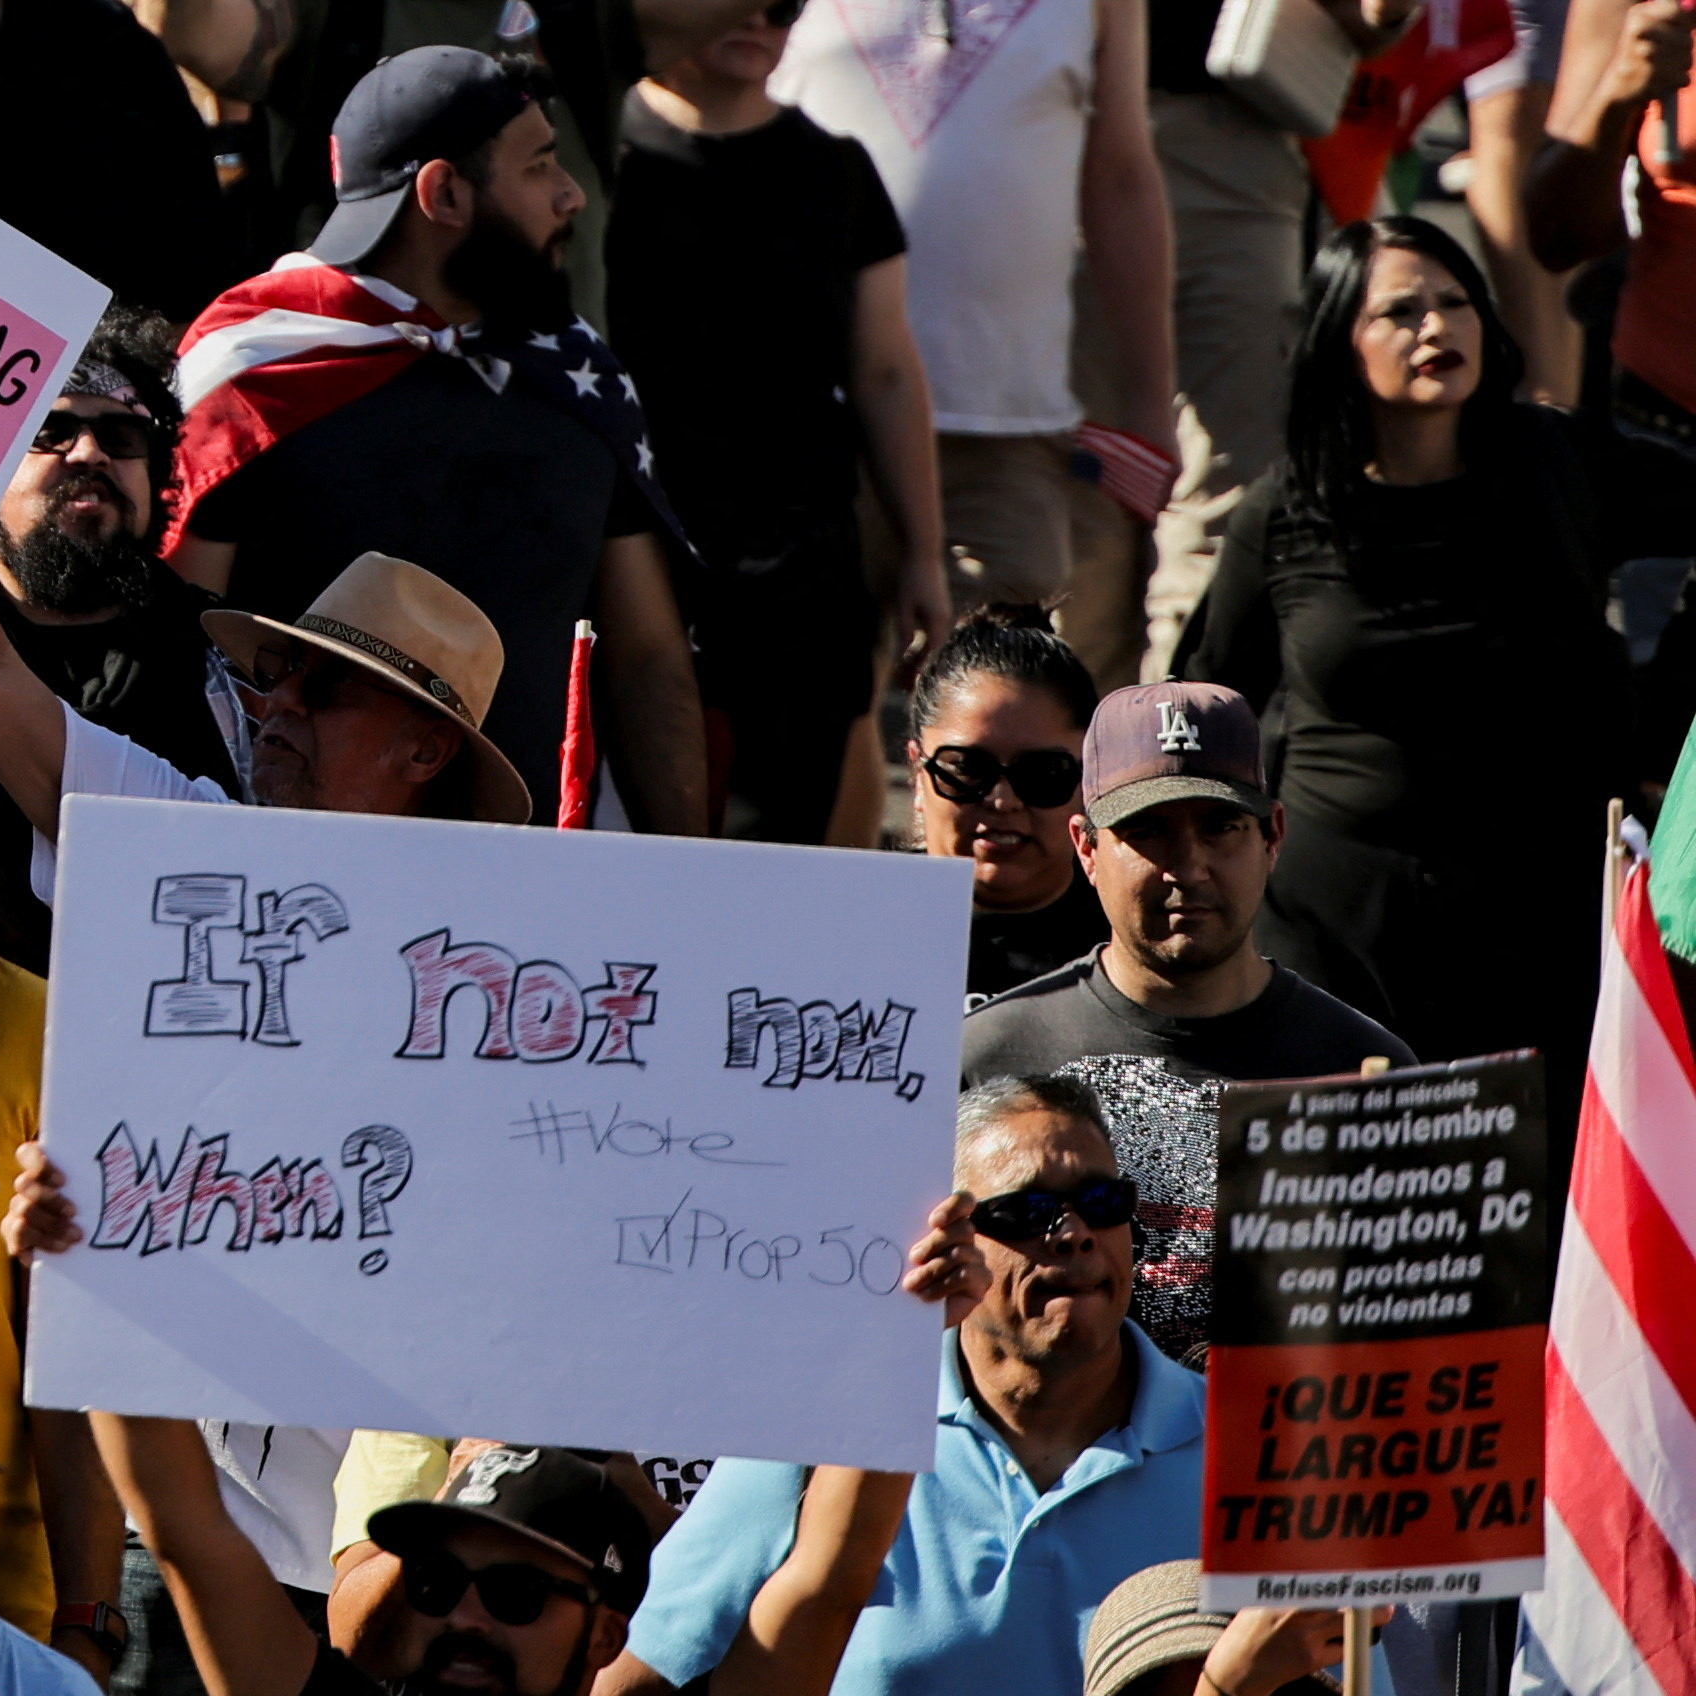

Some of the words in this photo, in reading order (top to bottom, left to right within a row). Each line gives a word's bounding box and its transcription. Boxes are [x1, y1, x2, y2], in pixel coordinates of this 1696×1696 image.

[1155, 700, 1203, 752] LA
[142, 871, 352, 1048] If
[393, 926, 660, 1067] not
[722, 984, 925, 1104] now,
[1246, 1119, 1271, 1154] 5
[1281, 1117, 1328, 1153] de
[1336, 1101, 1517, 1152] noviembre
[1307, 1089, 1359, 1119] partir
[1362, 1084, 1392, 1112] del
[506, 1100, 788, 1168] #Vote
[91, 1118, 414, 1278] When?
[1258, 1157, 1473, 1207] Inundemos
[1481, 1157, 1508, 1188] a
[1228, 1198, 1468, 1256] Washington,
[1478, 1190, 1533, 1232] DC
[807, 1224, 905, 1297] 50
[1277, 1264, 1337, 1293] con
[1343, 1252, 1485, 1294] protestas
[1289, 1303, 1330, 1330] no
[1336, 1289, 1472, 1327] violentas
[1259, 1368, 1410, 1433] ¡QUE
[1425, 1361, 1501, 1413] SE
[1255, 1421, 1502, 1484] LARGUE
[1215, 1487, 1429, 1545] TRUMP
[1449, 1475, 1538, 1534] YA!
[1256, 1569, 1482, 1602] RefuseFascism.org
